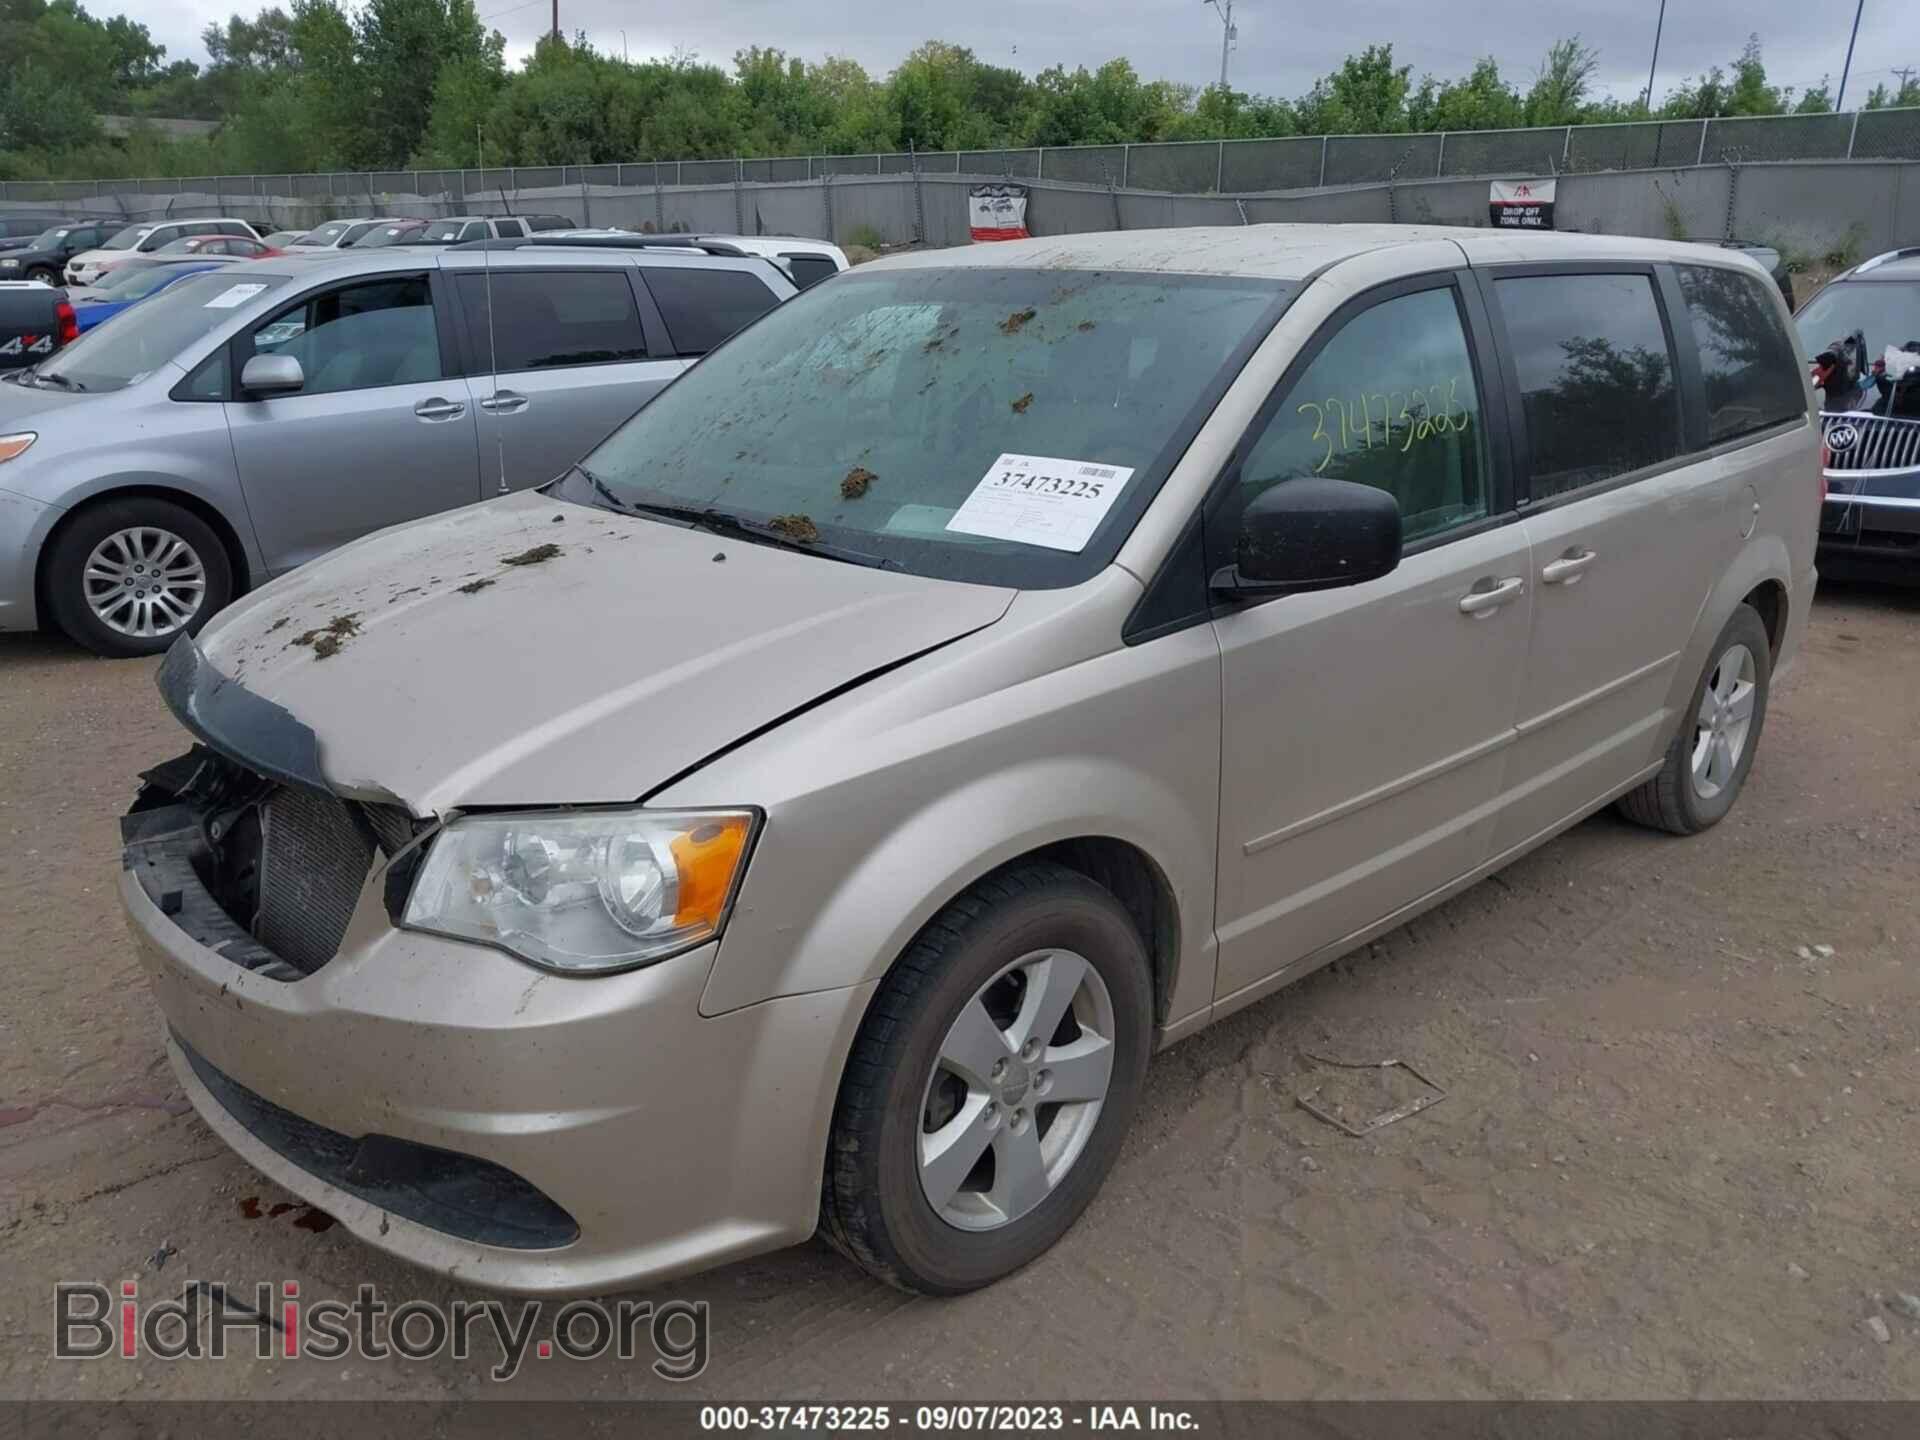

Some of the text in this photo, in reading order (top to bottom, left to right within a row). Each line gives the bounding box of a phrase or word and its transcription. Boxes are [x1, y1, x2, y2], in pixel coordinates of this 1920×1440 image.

[1503, 207, 1540, 216] DROP OFF
[1521, 216, 1542, 225] ONLY
[993, 471, 1105, 499] 37473225
